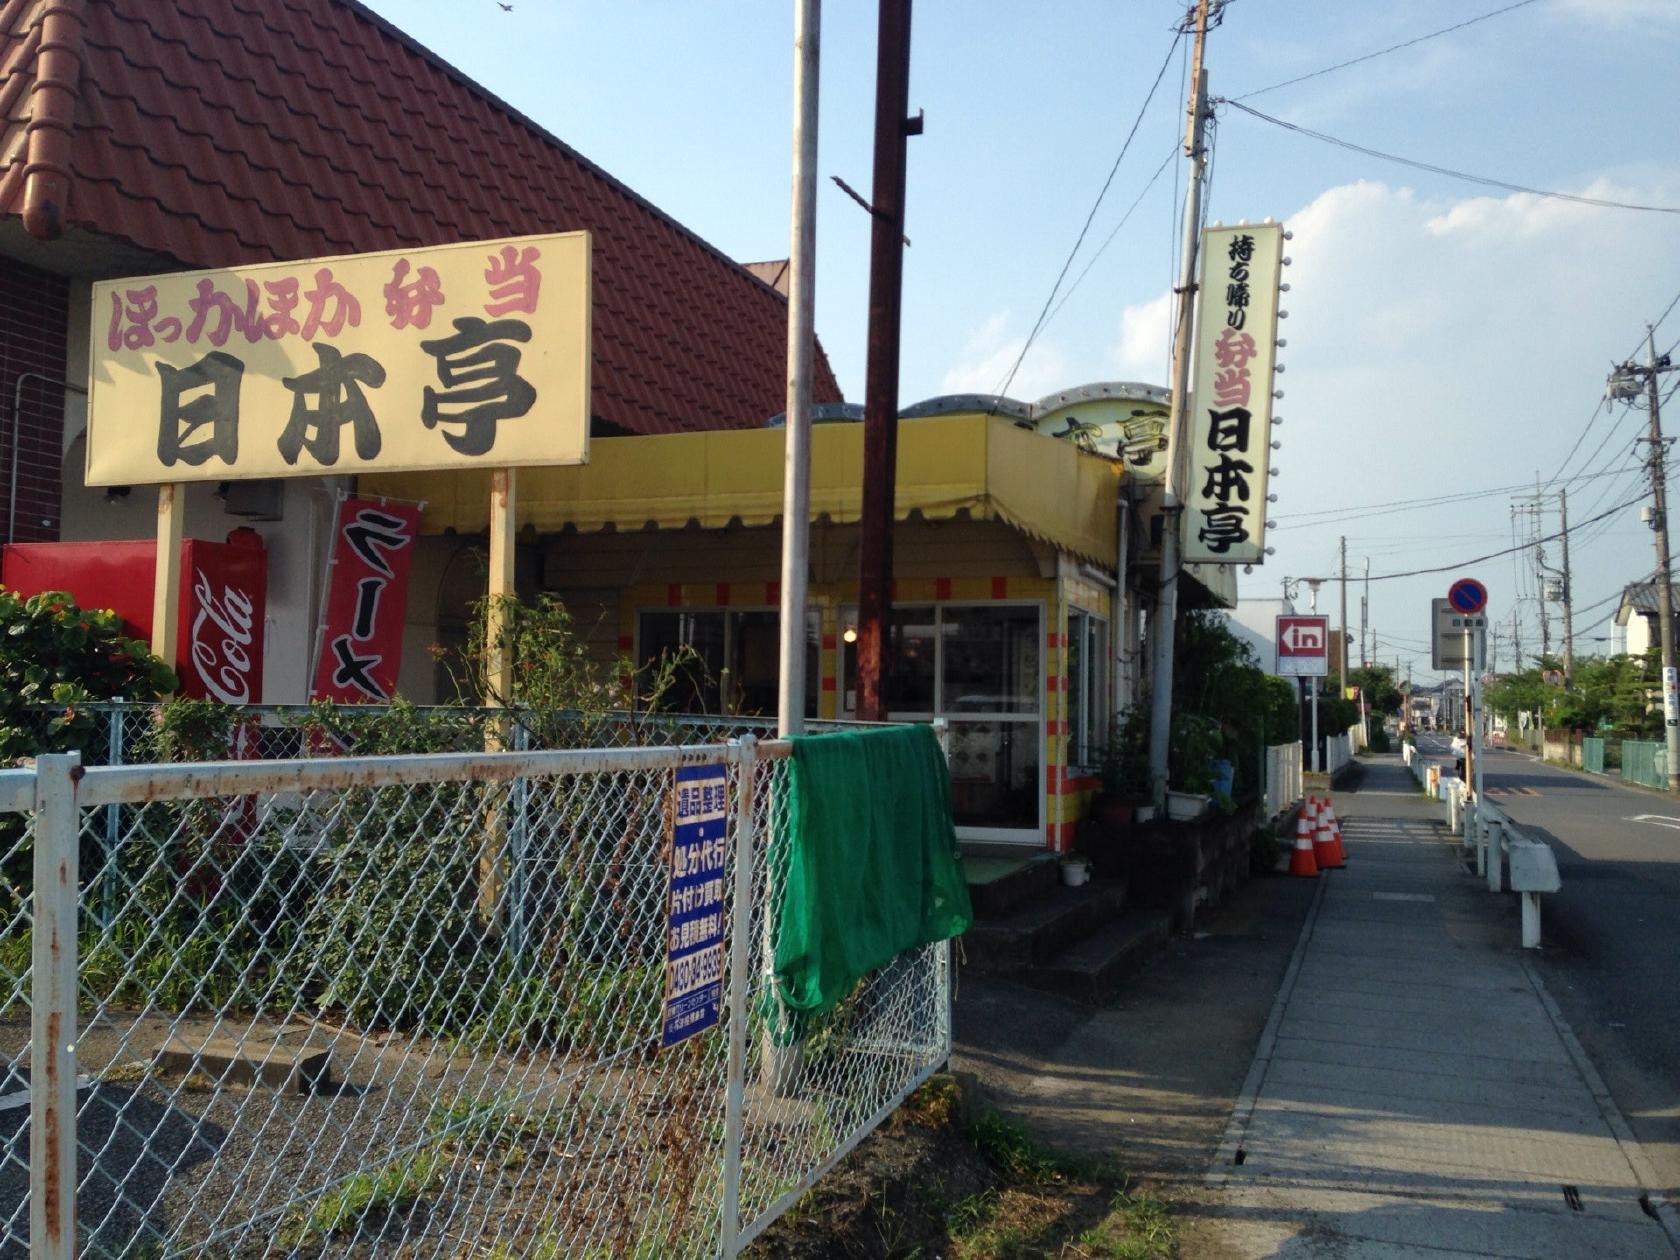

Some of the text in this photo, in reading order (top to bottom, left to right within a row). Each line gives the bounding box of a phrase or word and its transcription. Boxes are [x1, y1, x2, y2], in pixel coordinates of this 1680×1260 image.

[108, 246, 541, 351] ほっかほか弁当
[155, 317, 537, 467] 日本亭
[1213, 328, 1256, 407] 弁当
[1198, 408, 1253, 553] 日本亭
[325, 508, 411, 750] ラーメ
[1292, 628, 1318, 647] in
[677, 784, 726, 818] 遺品整理
[672, 837, 725, 879] 処分代行
